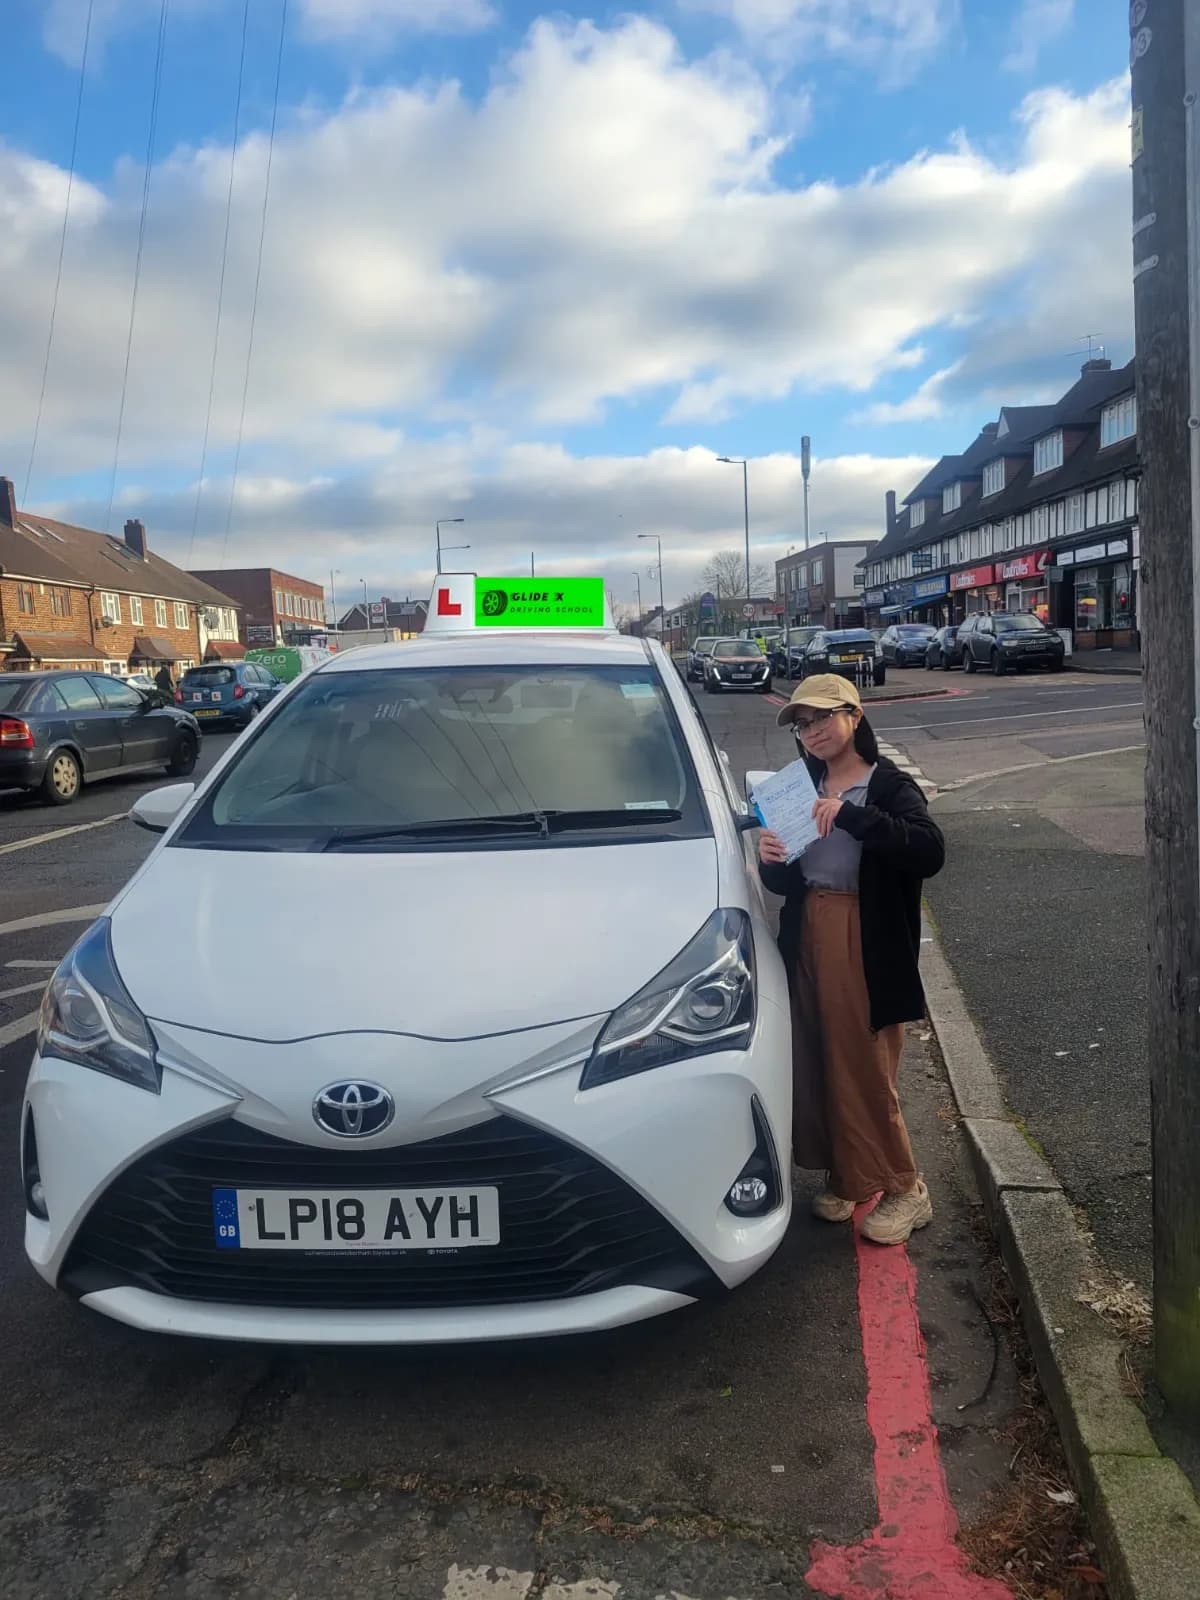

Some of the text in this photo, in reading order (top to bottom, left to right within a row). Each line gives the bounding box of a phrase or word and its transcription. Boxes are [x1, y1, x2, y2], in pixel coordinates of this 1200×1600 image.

[438, 589, 462, 615] L
[511, 592, 565, 602] GLIDE X
[255, 1195, 480, 1241] LP18 AYH
[219, 1225, 236, 1237] GB
